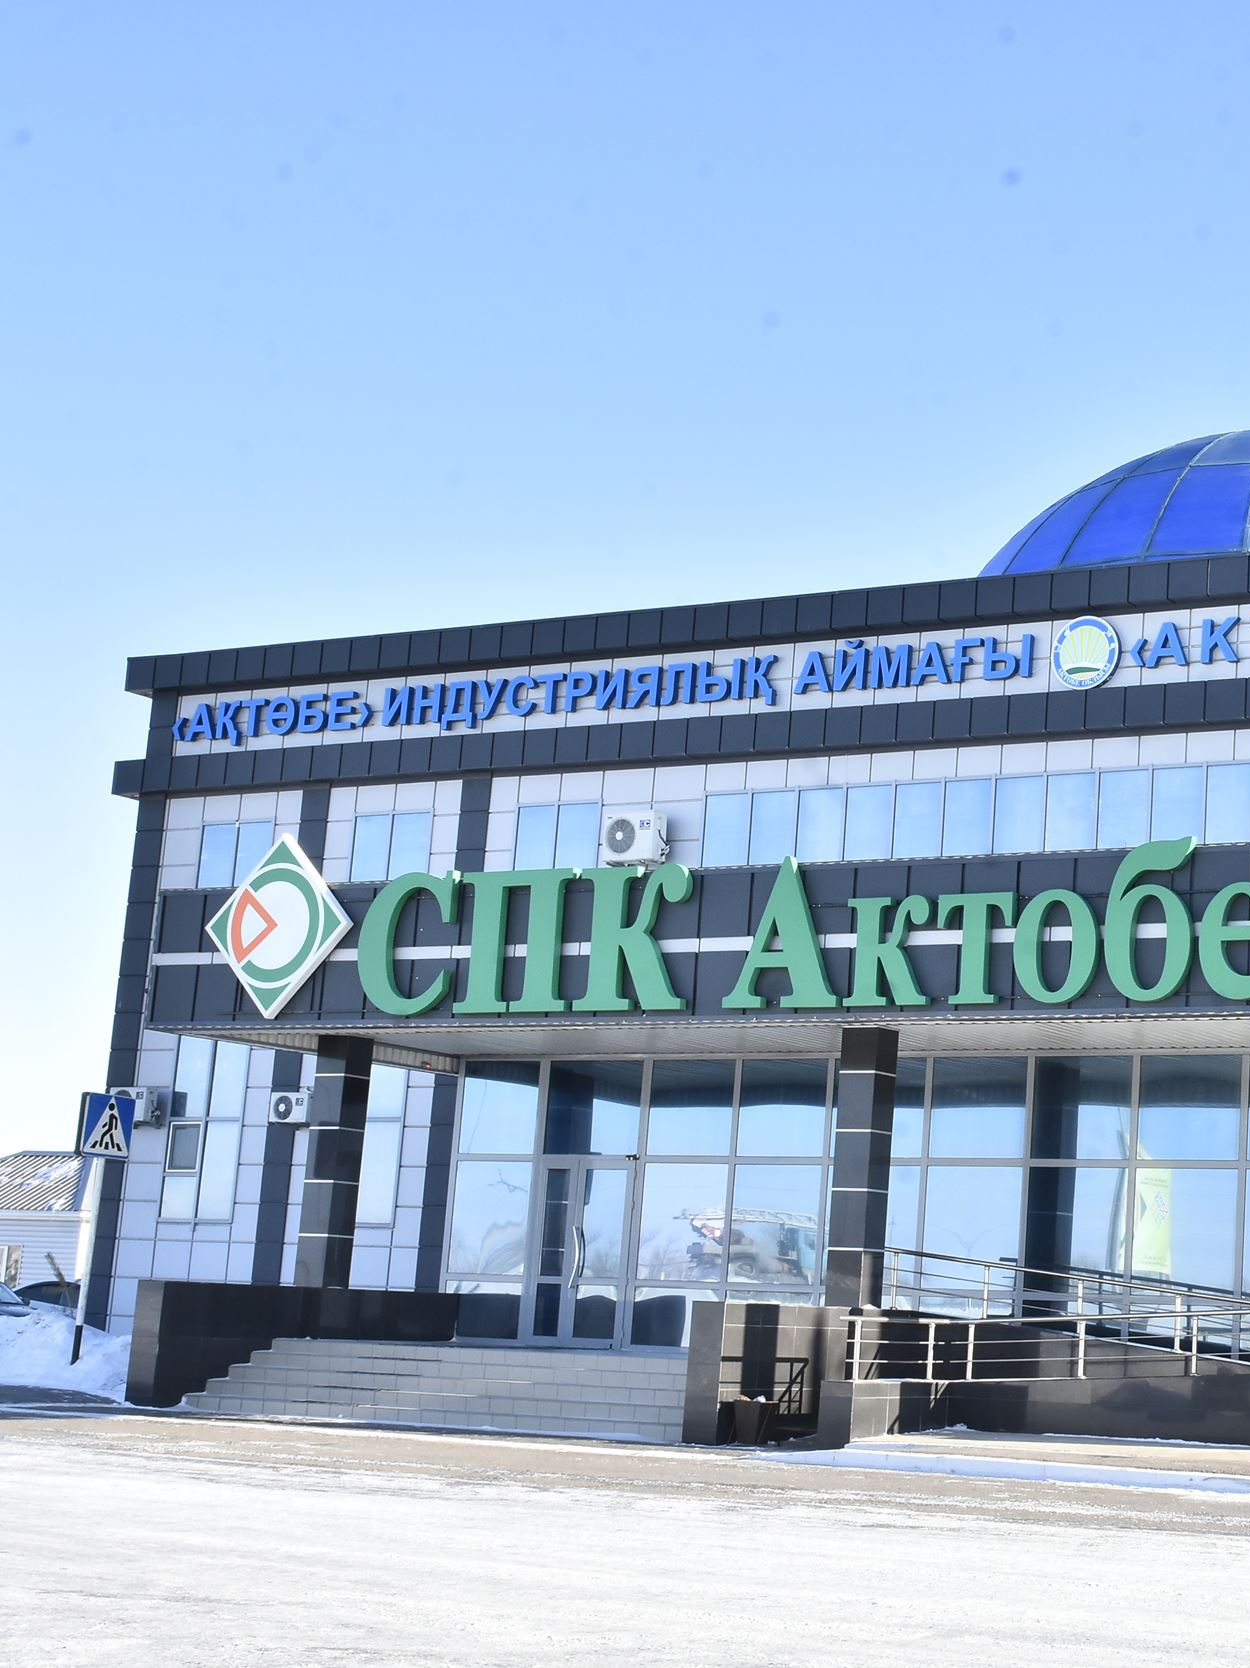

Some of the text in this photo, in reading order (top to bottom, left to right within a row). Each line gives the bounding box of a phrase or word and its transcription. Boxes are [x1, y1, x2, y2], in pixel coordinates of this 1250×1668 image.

[381, 654, 780, 732] ИНДУСТРИЯЛЫҚ
[794, 633, 1036, 695] АЙМАҒЫ
[356, 862, 695, 1018] СПК
